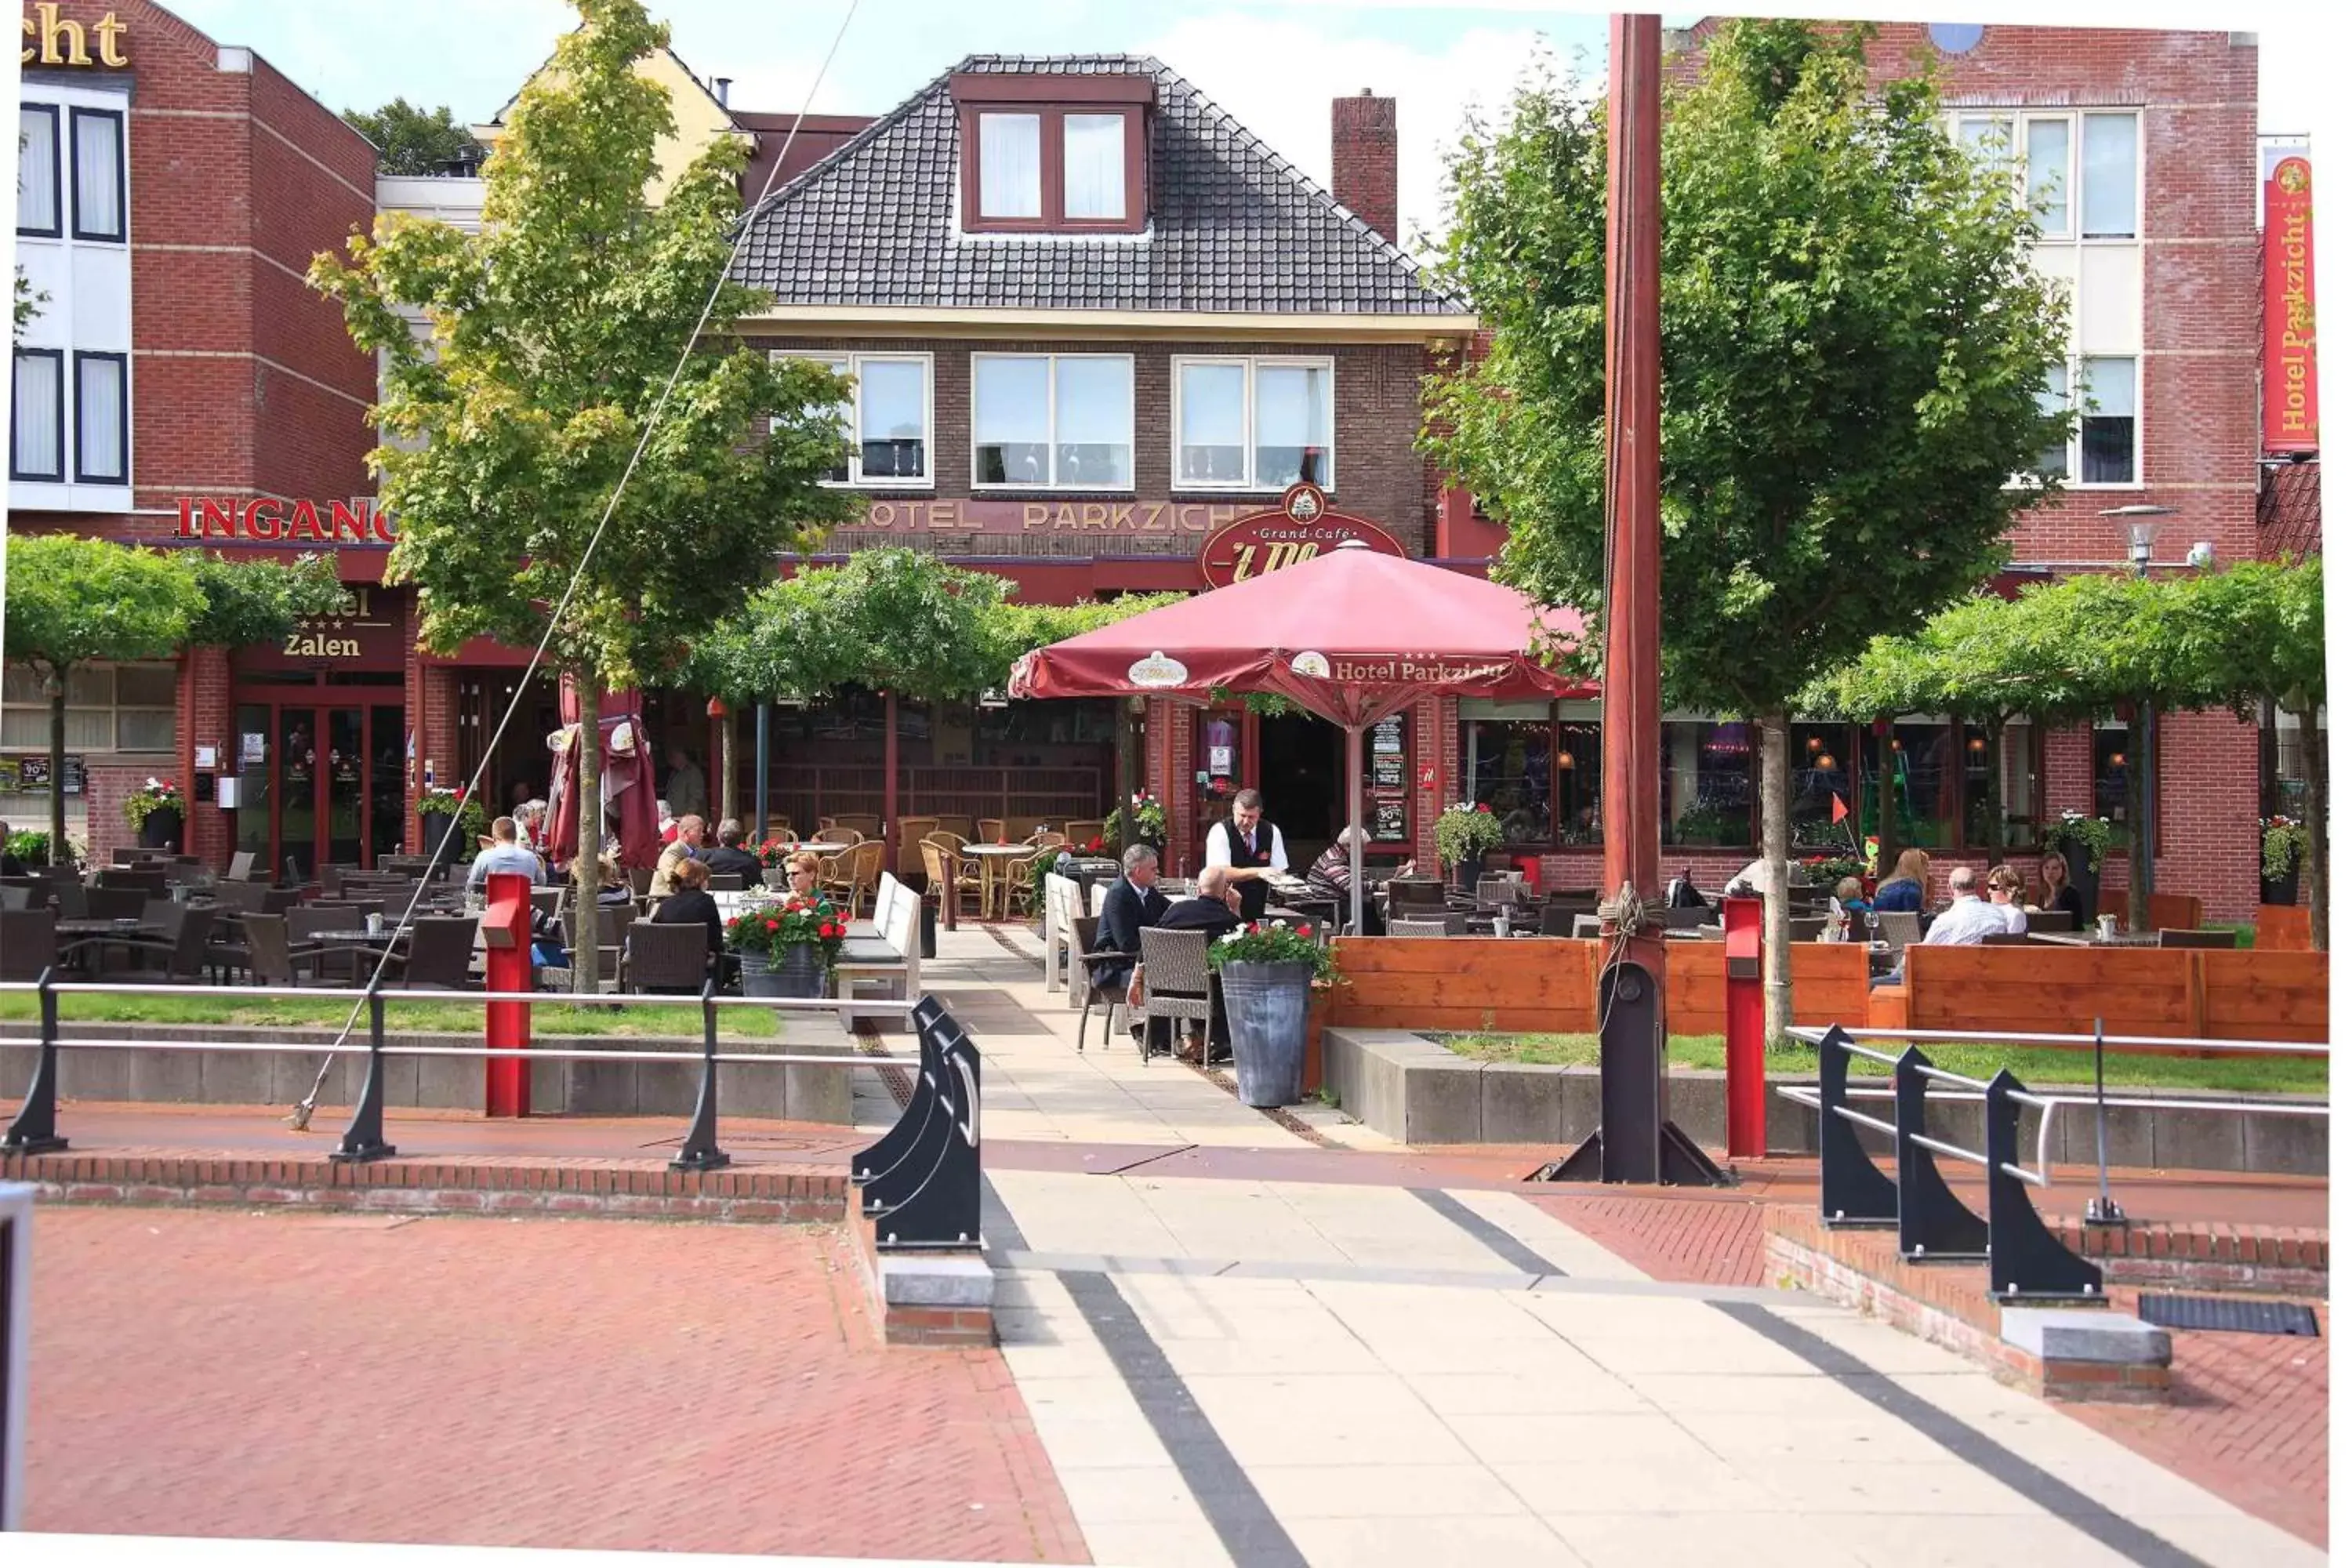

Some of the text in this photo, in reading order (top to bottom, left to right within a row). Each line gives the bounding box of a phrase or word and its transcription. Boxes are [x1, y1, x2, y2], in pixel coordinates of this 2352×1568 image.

[2281, 212, 2307, 433] Hotel Parkzicht
[284, 633, 361, 656] Zalen
[1336, 662, 1396, 680] Hotel
